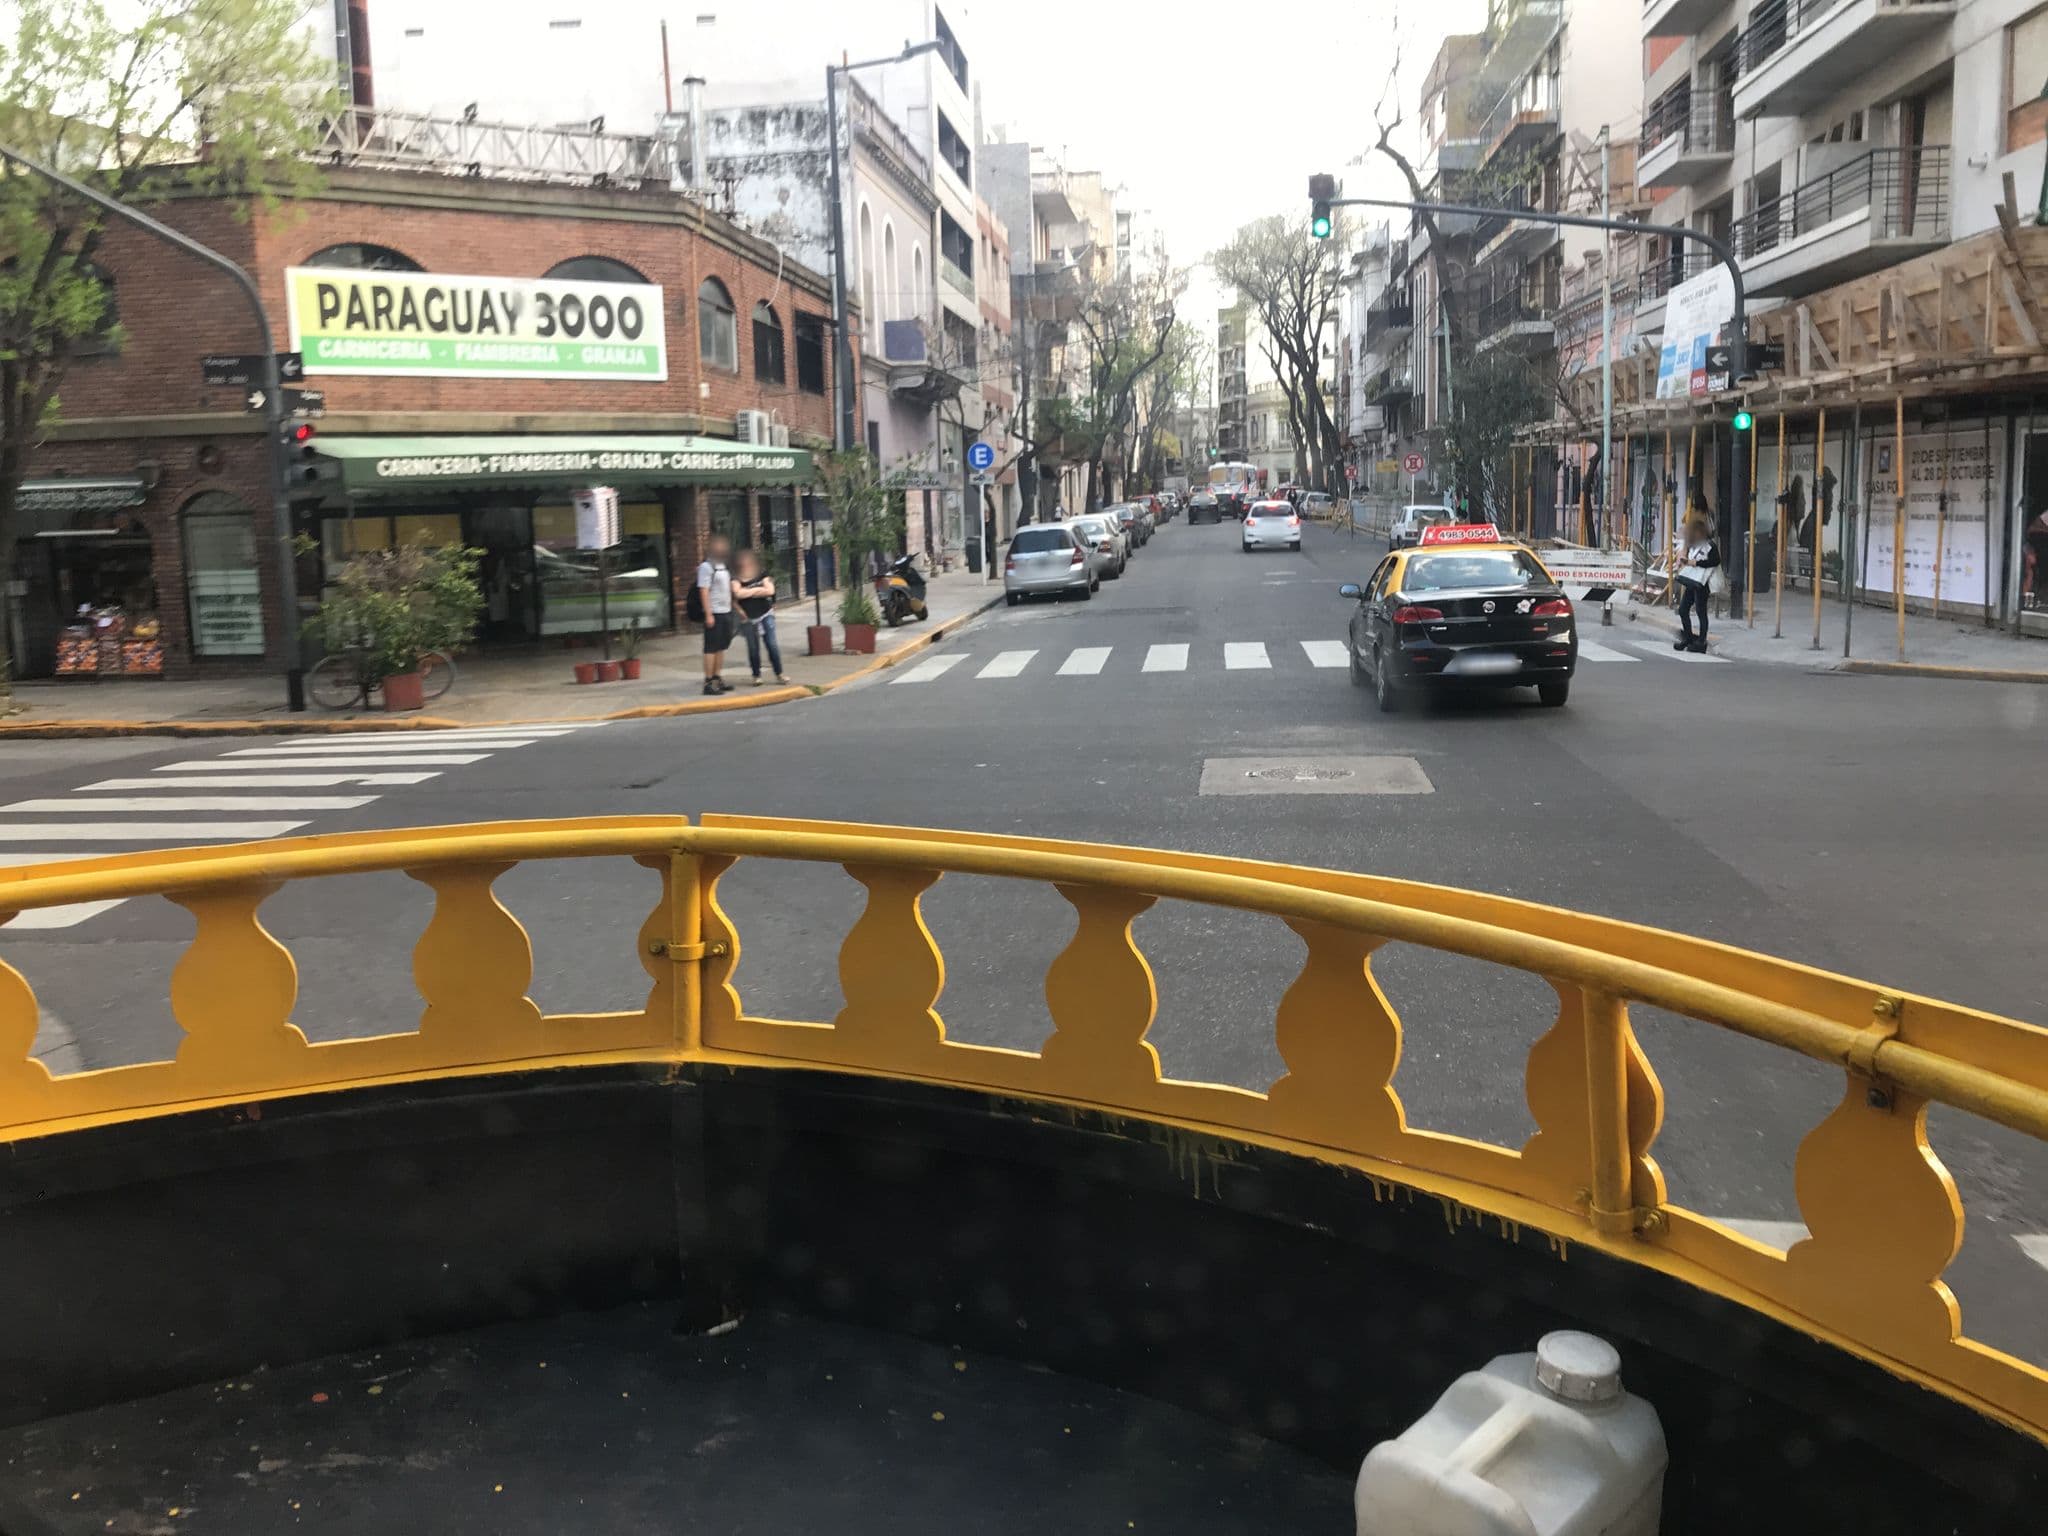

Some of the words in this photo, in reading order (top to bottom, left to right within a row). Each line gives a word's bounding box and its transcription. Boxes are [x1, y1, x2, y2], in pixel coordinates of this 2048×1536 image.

[317, 283, 522, 335] PARAGUAY
[535, 291, 643, 340] 3000
[317, 338, 432, 361] CARNICERIA
[455, 342, 559, 364] FIAMBRERIA
[581, 345, 646, 365] GRANJA
[377, 456, 482, 476] CARNICERIA
[489, 453, 592, 473] FIAMBRERIA
[598, 453, 663, 469] GRANJA
[670, 453, 720, 469] CARNE
[975, 447, 988, 465] E
[1440, 529, 1465, 539] 4983
[1550, 570, 1569, 578] BIDO
[1572, 571, 1627, 579] ESTACIONAR
